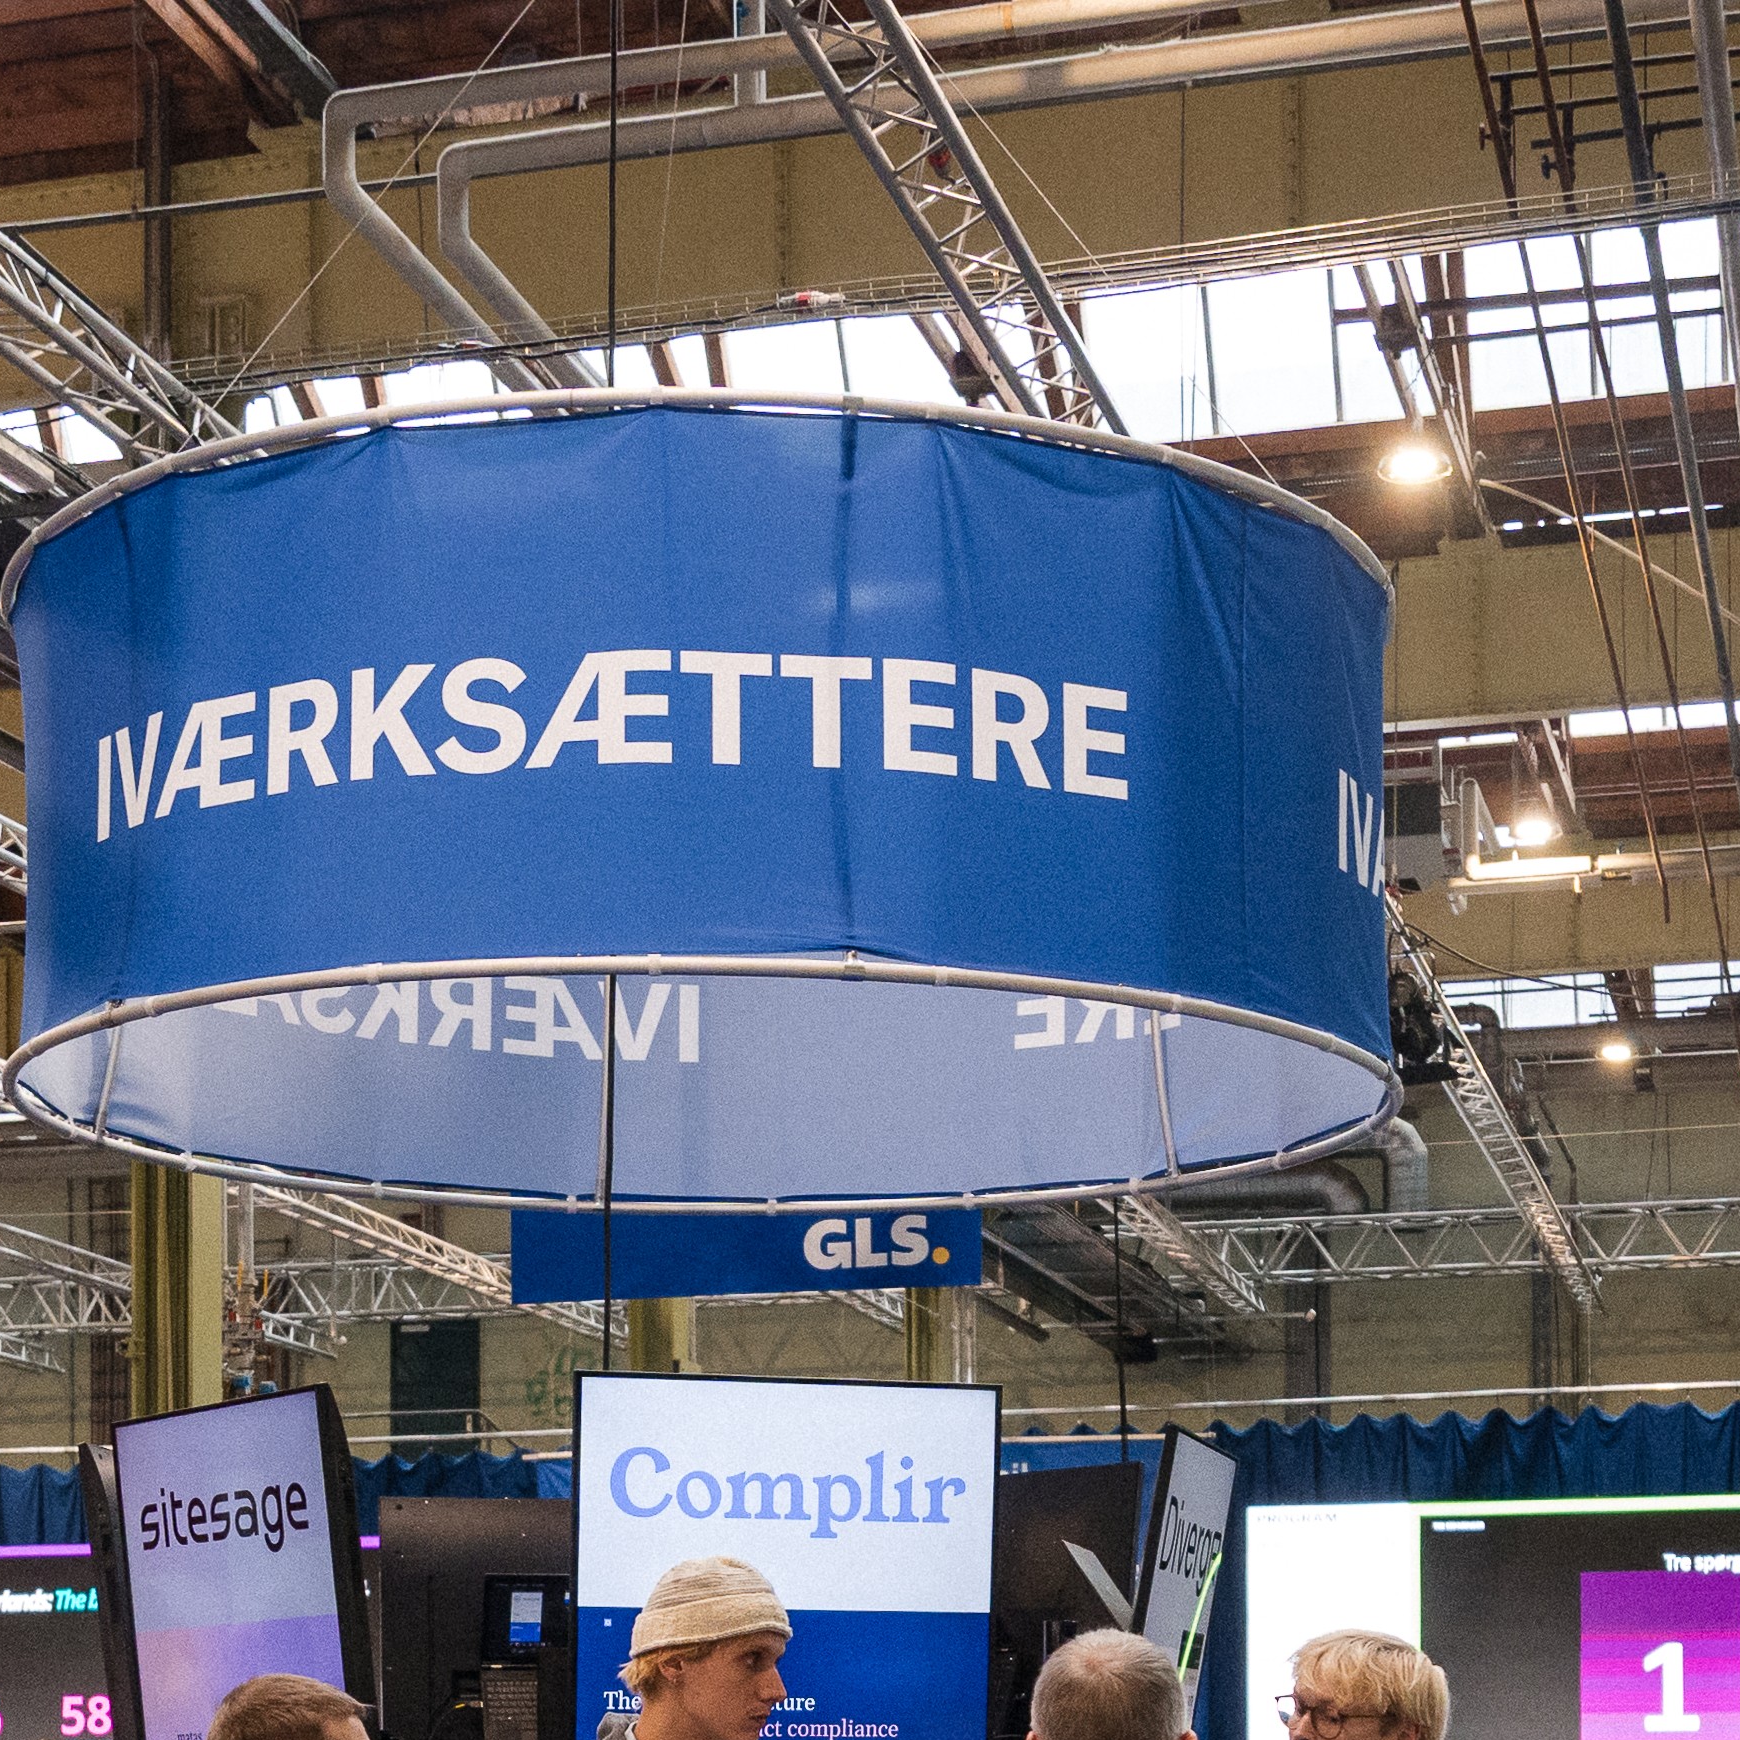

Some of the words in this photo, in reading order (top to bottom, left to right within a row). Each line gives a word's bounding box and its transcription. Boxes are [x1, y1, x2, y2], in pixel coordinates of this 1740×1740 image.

[97, 649, 1129, 842] IVÆRKSÆTTERE
[610, 1446, 966, 1539] Complir
[141, 1482, 309, 1553] sitesage
[1257, 1513, 1338, 1523] PROGRAM
[1664, 1552, 1691, 1572] Tre
[55, 1588, 86, 1611] The
[603, 1690, 643, 1711] The
[1643, 1641, 1701, 1733] 1
